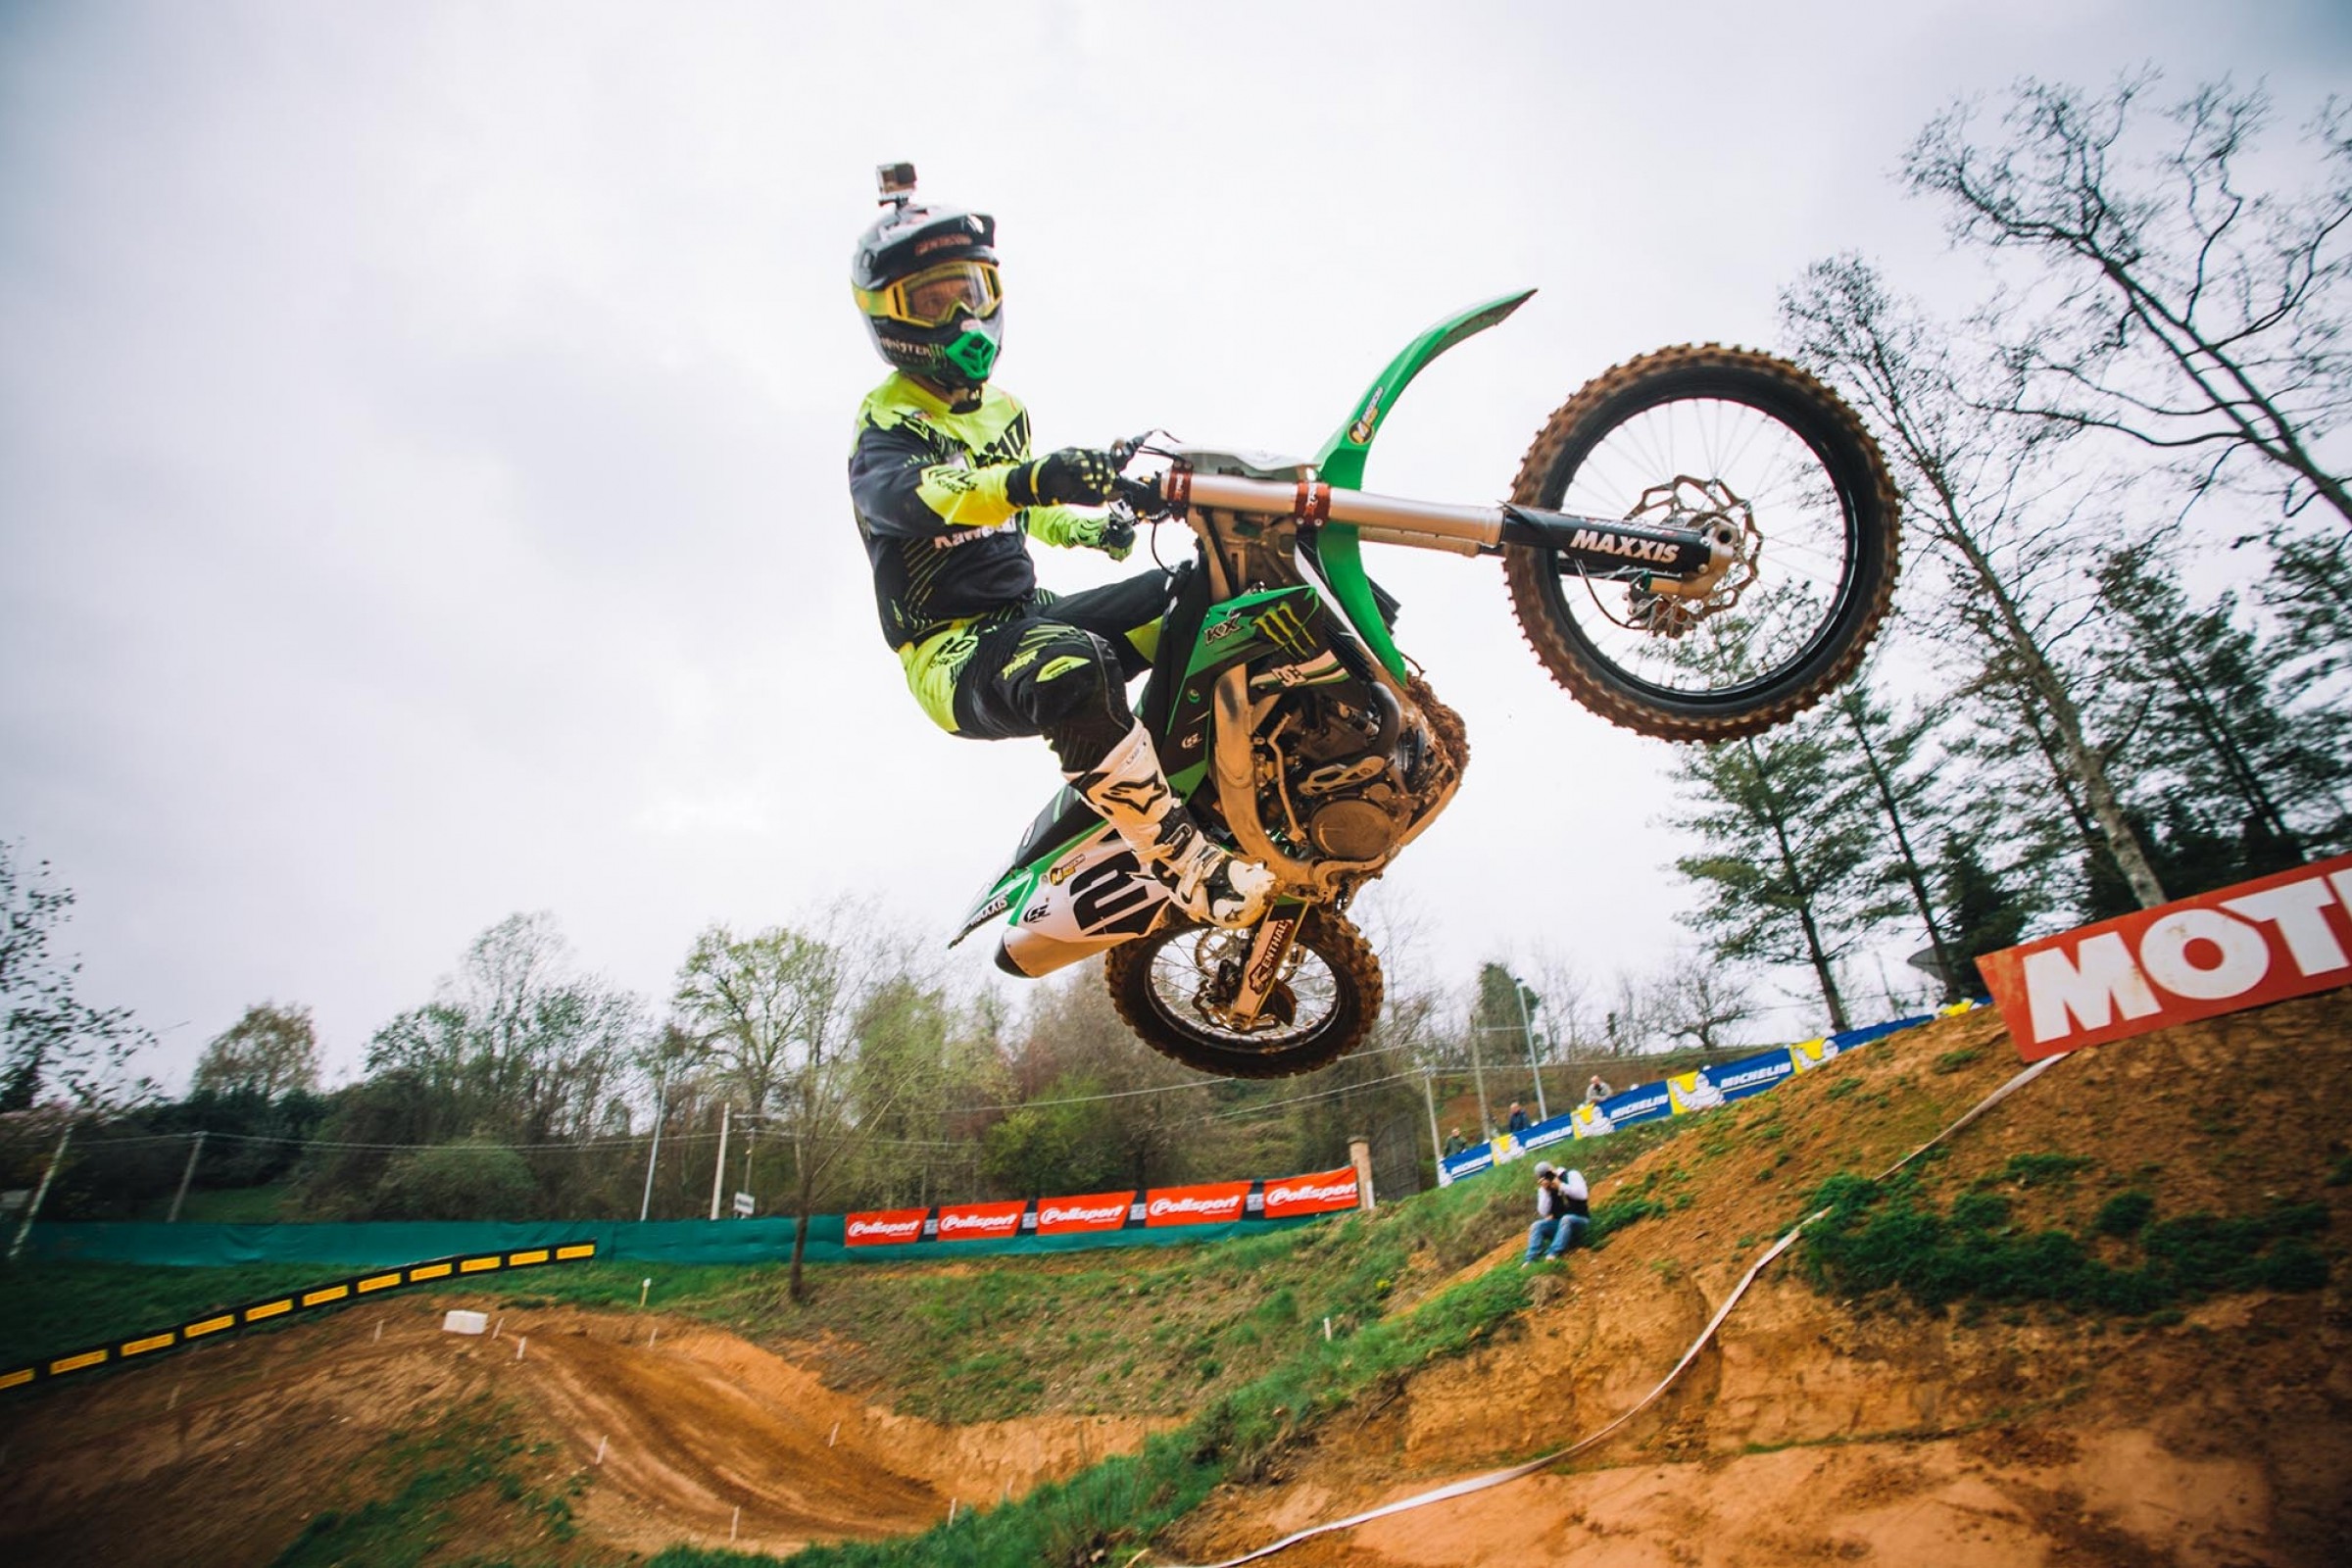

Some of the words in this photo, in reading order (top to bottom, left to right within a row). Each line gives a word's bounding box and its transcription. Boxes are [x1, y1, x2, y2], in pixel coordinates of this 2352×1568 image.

[1570, 528, 1680, 564] MAXXIS
[1204, 613, 1242, 646] KX
[1720, 1061, 1791, 1089] MICHELIN
[1040, 1204, 1125, 1224] Polisport
[1149, 1194, 1240, 1216] Polisport
